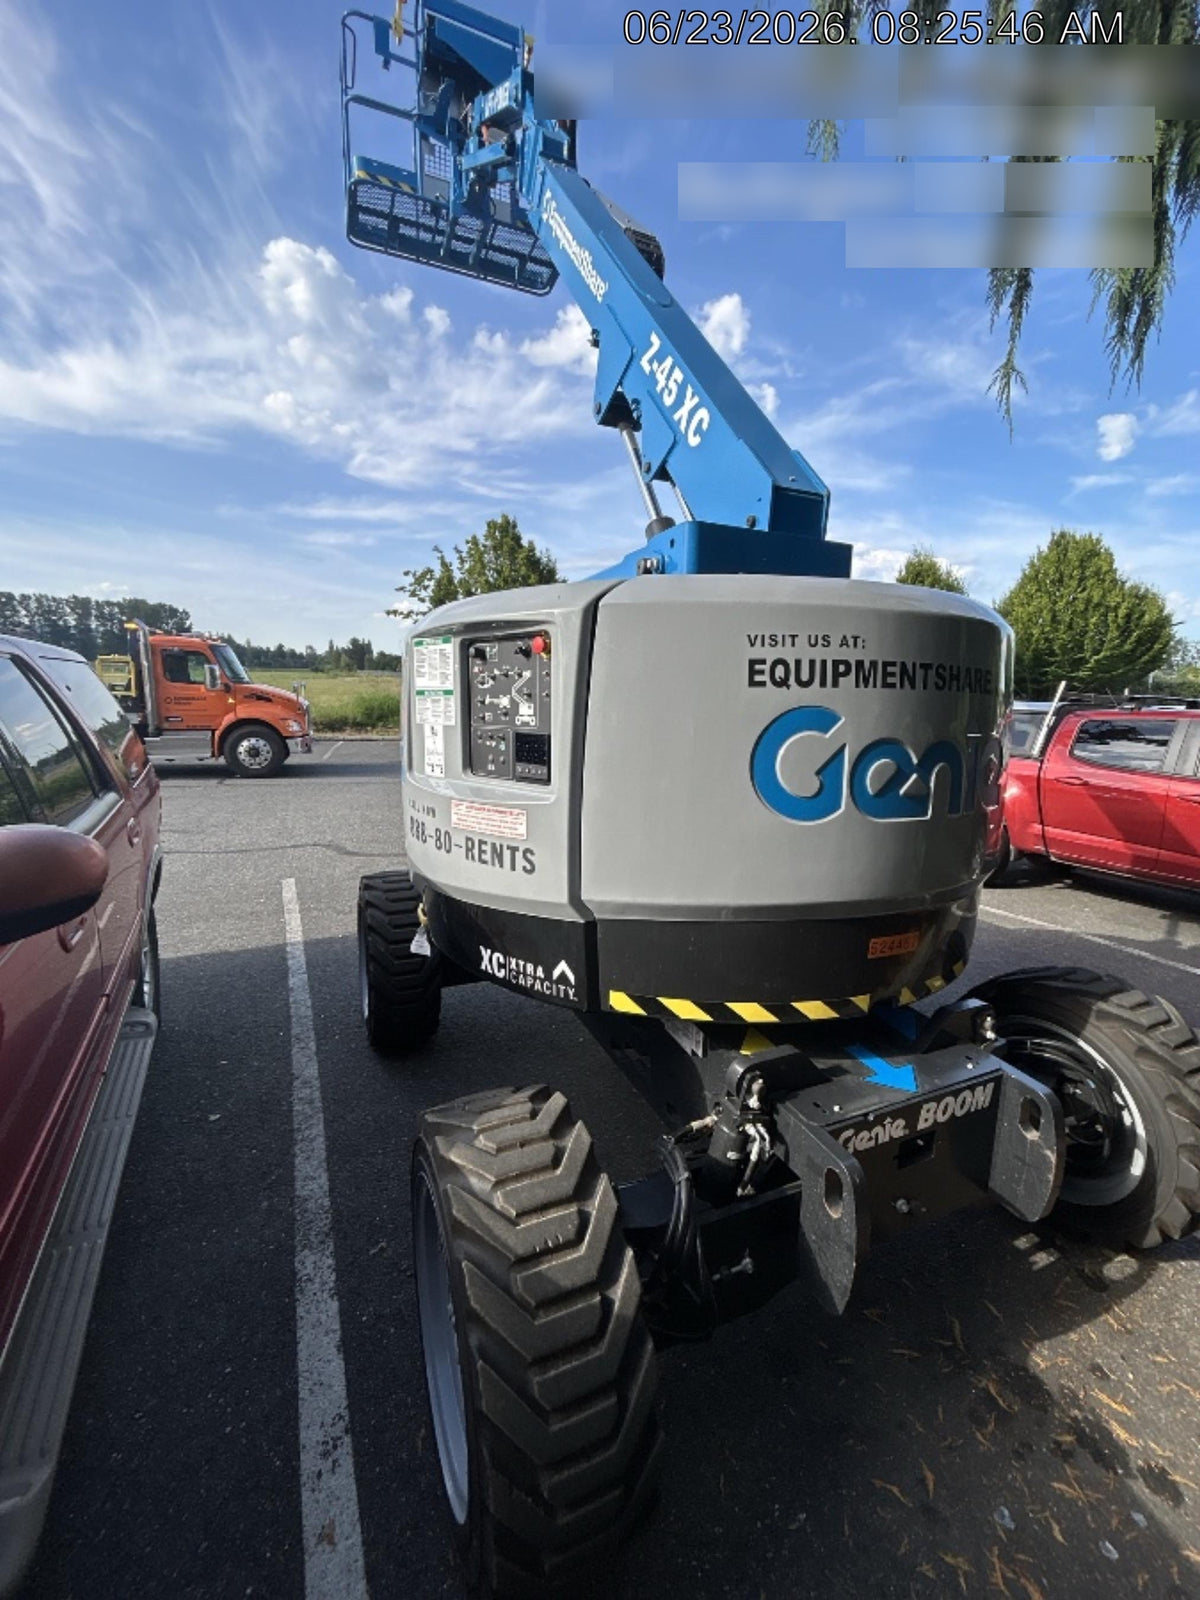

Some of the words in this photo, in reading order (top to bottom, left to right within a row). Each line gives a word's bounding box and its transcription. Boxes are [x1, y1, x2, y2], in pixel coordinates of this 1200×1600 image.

[640, 330, 684, 407] Z-45
[673, 383, 710, 447] XC
[747, 634, 799, 648] VISIT
[808, 634, 831, 648] US
[839, 635, 866, 649] AT:
[748, 657, 992, 694] EQUIPMENTSHARE
[480, 945, 506, 979] XC
[510, 956, 545, 979] XTRA
[510, 970, 577, 1000] CAPACITY
[917, 1082, 995, 1131] BOOM
